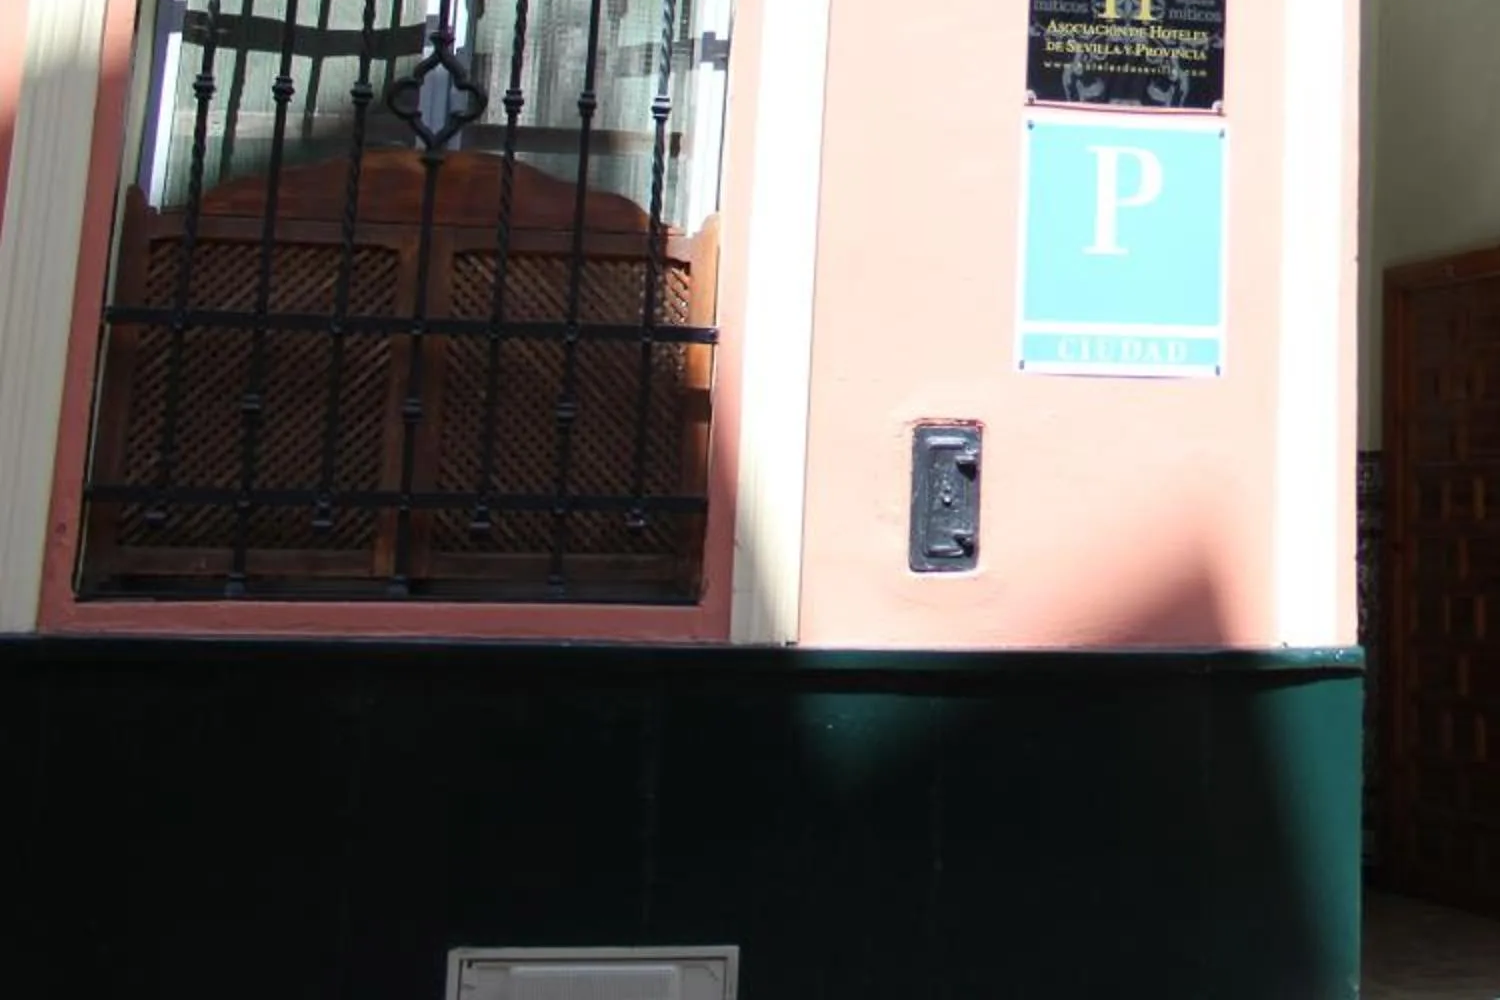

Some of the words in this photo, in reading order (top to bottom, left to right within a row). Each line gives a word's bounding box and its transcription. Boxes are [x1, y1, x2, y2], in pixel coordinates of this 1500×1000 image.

[1150, 26, 1208, 42] HOTELES
[1065, 40, 1123, 55] SEVILLA
[1135, 43, 1208, 61] PROVINCIA
[1082, 145, 1163, 256] P
[1057, 337, 1188, 362] CIUDAD
